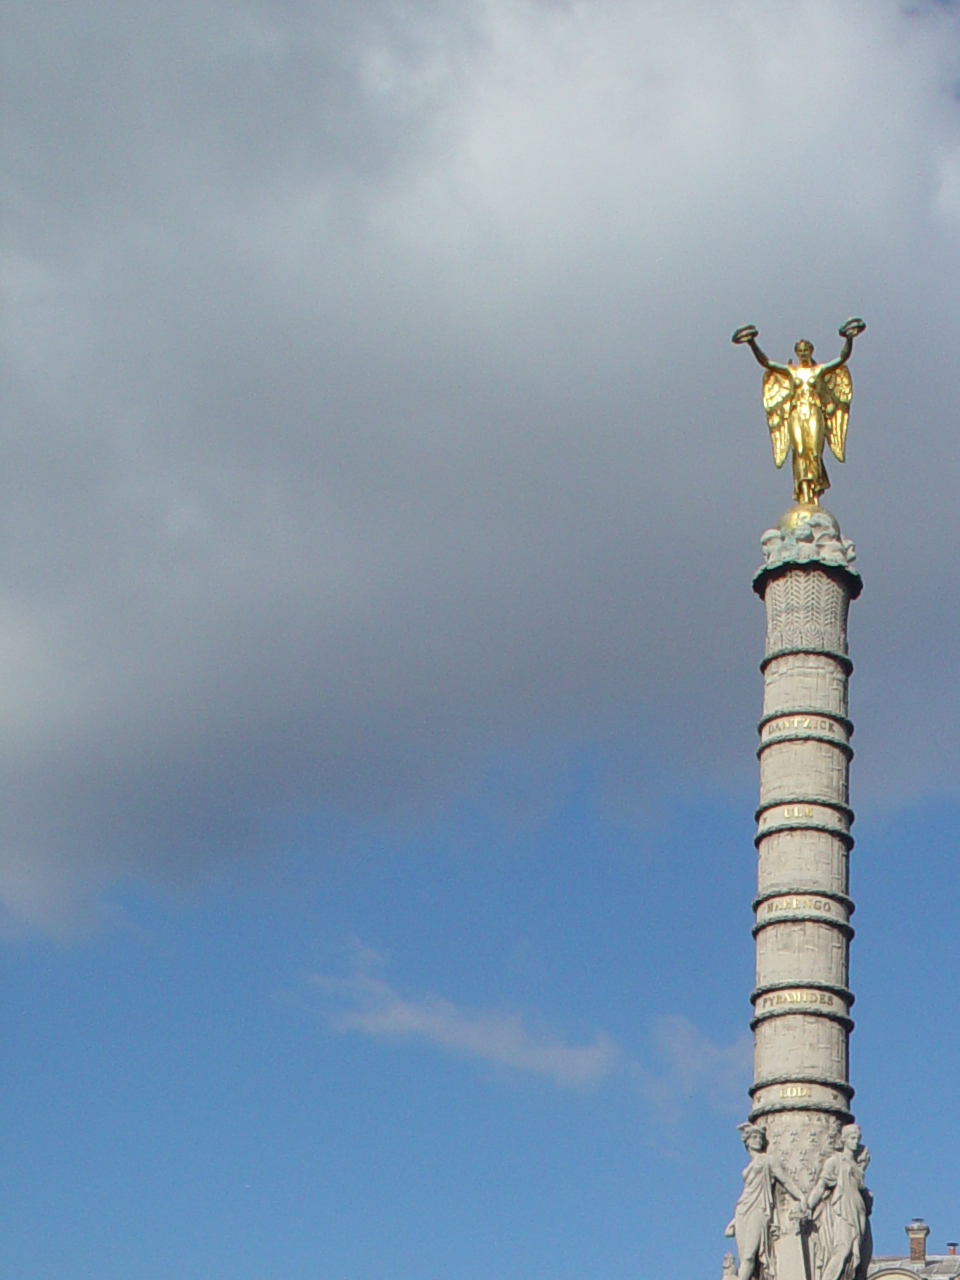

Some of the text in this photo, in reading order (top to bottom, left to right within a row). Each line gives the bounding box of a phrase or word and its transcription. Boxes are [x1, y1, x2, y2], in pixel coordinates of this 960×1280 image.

[768, 717, 836, 736] DANTZICK
[784, 806, 814, 819] ULM
[766, 898, 832, 914] MARENGO
[762, 991, 834, 1009] PYRAMIDES
[780, 1086, 812, 1099] LODI
